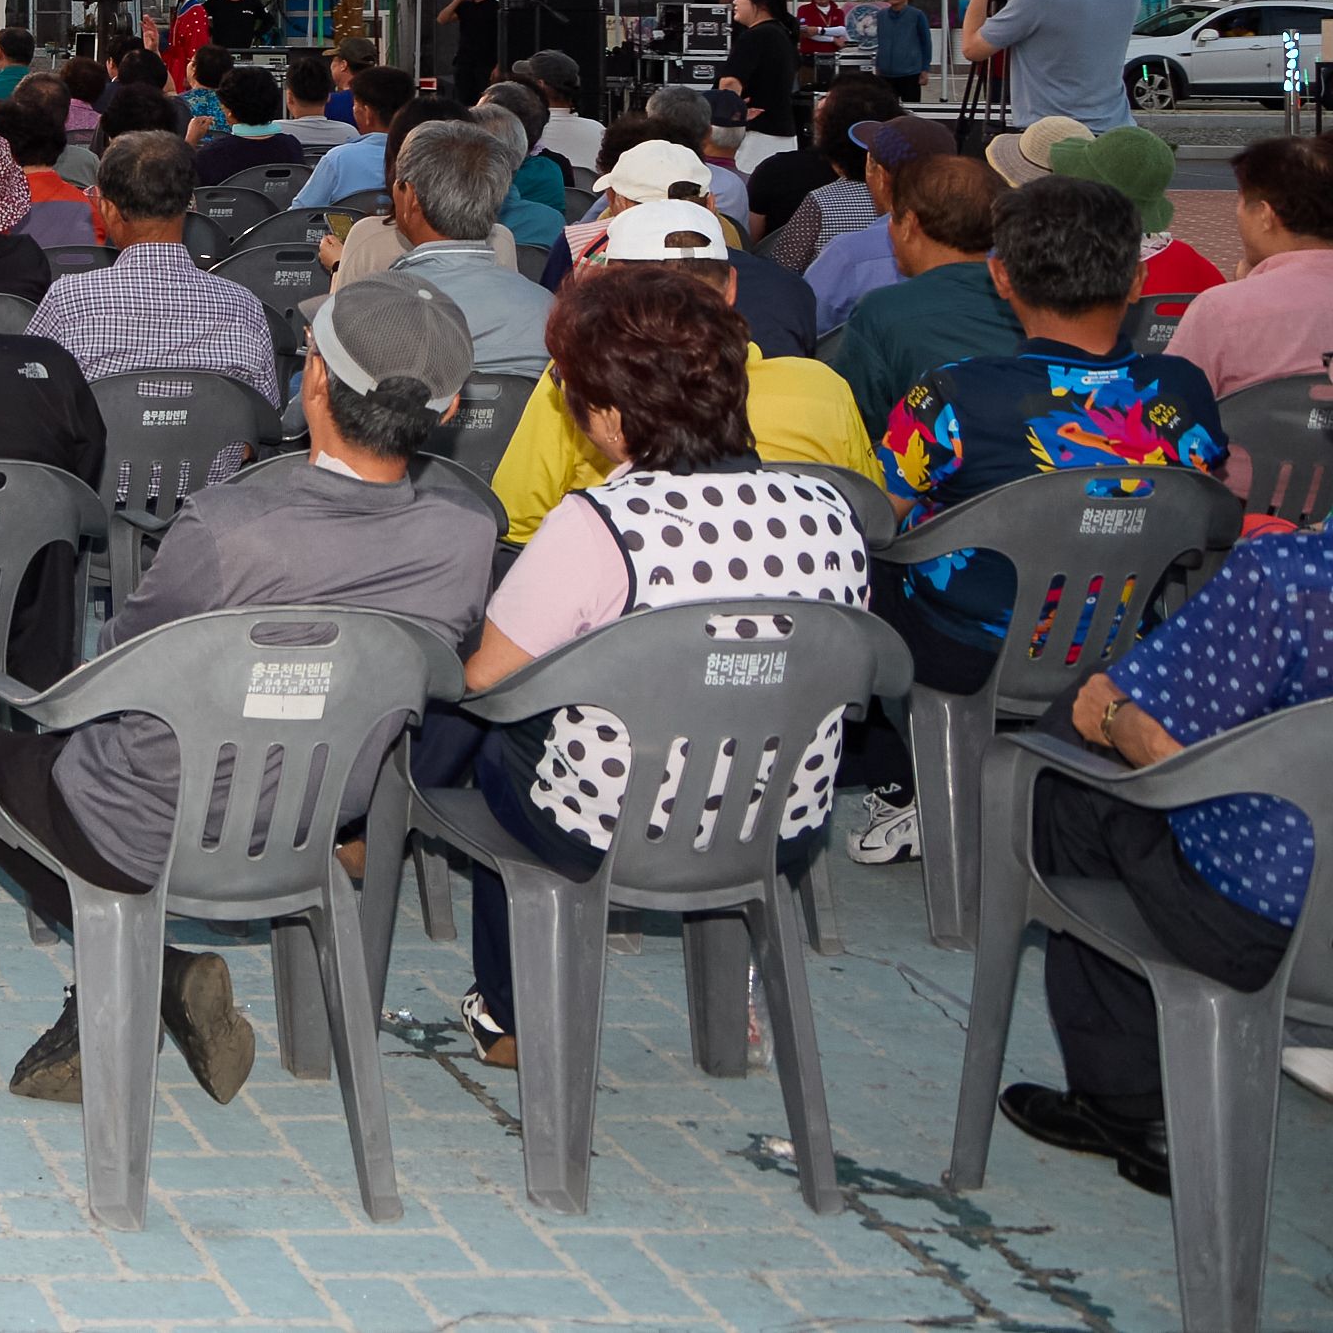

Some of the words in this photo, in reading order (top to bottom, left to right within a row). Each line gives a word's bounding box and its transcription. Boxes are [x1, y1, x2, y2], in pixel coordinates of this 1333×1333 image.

[142, 409, 188, 421] 충무종합렌탈
[1081, 507, 1148, 527] 한려렌탈기획
[251, 661, 334, 678] 충무천막렌탈
[705, 650, 788, 677] 한려렌탈기획
[250, 676, 331, 686] T.644-2014
